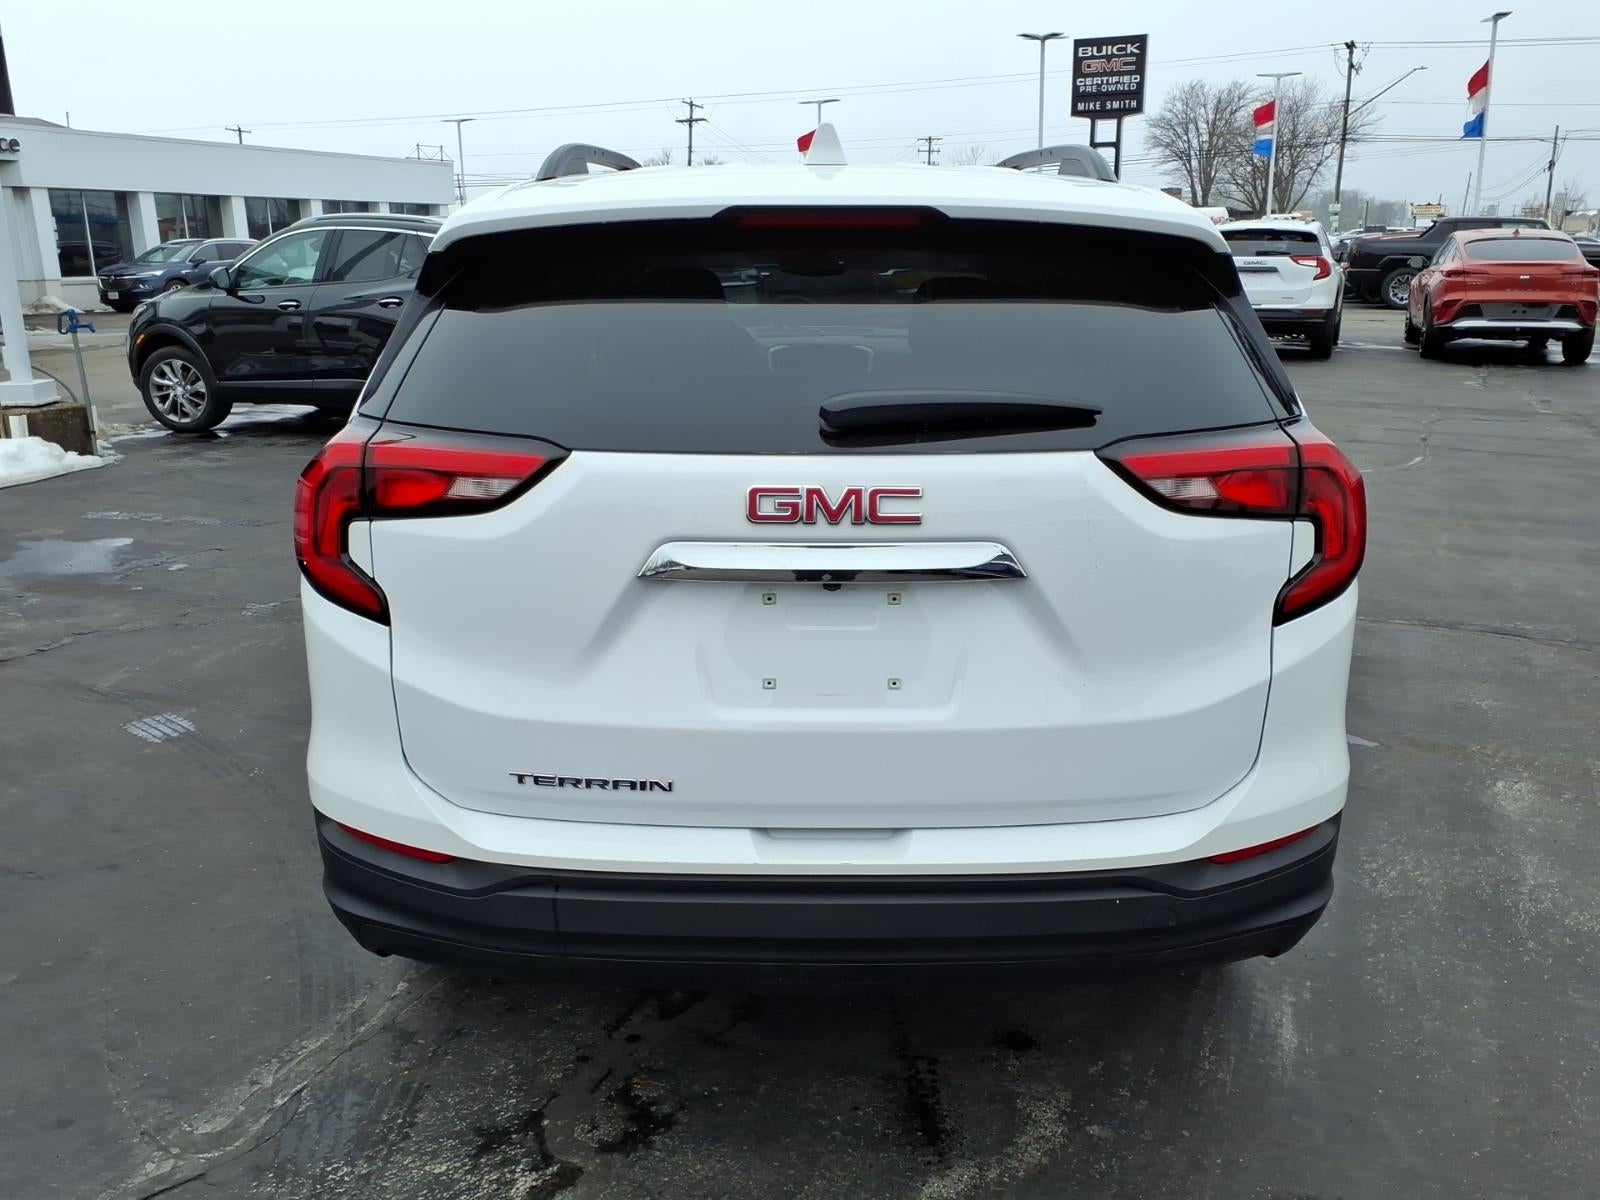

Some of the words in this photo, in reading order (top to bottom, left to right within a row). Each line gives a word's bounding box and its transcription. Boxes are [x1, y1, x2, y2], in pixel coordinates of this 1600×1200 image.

[1078, 43, 1141, 57] BUICK
[1081, 57, 1137, 73] GMC
[1076, 75, 1140, 86] CERTIFIED
[1079, 83, 1137, 93] PRE-OWNED
[1077, 102, 1101, 111] MIKE
[1105, 100, 1137, 110] SMITH
[746, 485, 923, 525] GMC
[509, 771, 674, 793] TERRAIN
